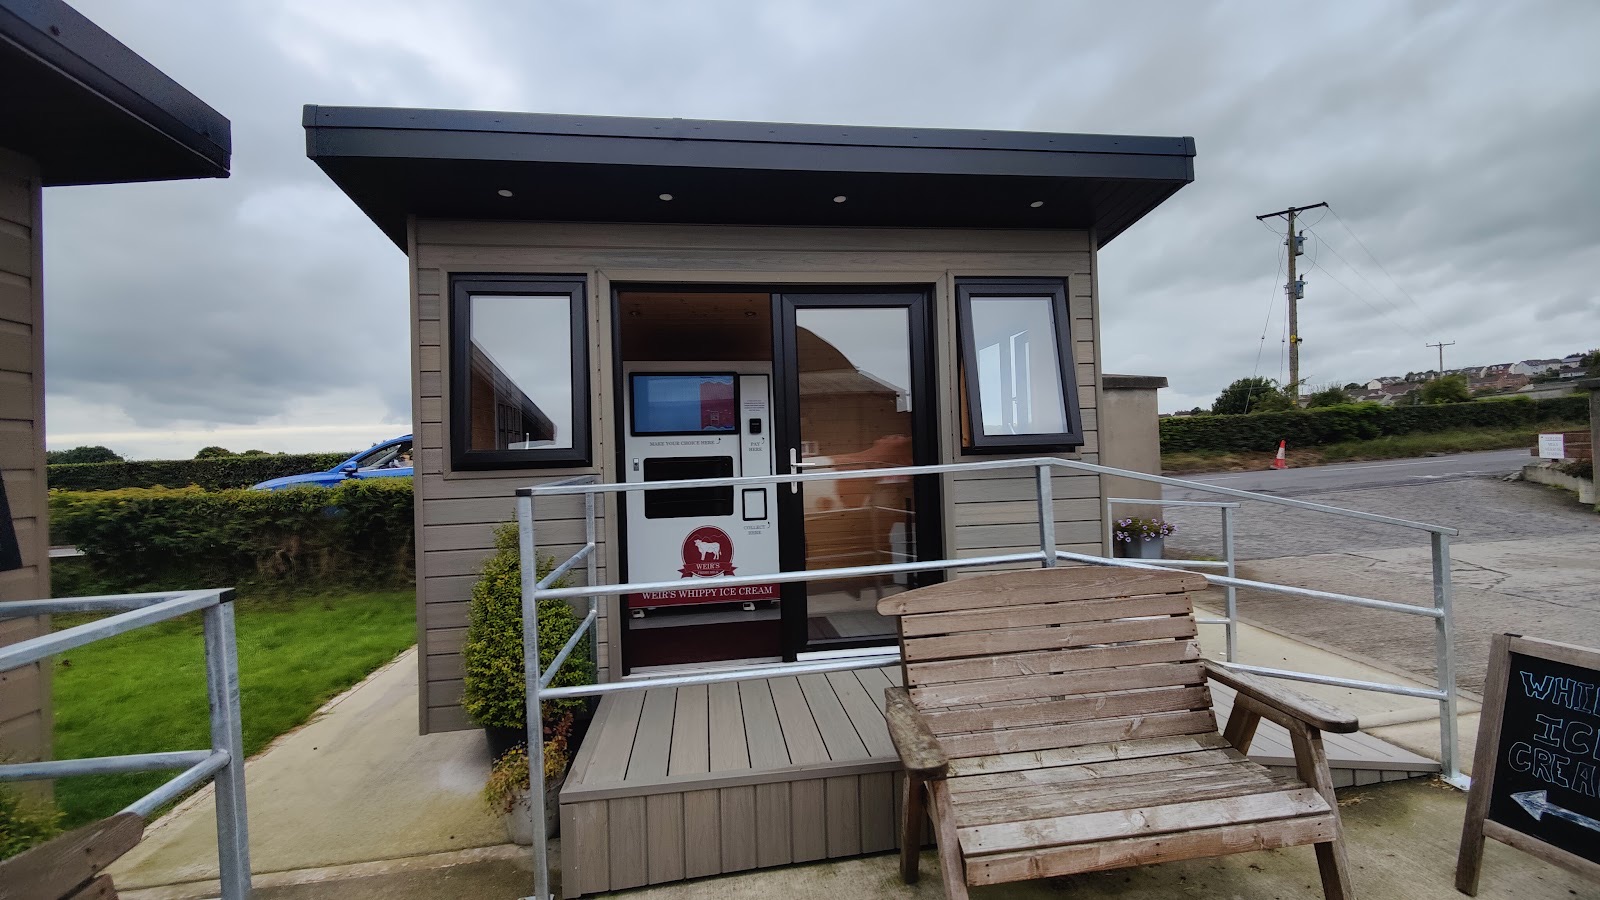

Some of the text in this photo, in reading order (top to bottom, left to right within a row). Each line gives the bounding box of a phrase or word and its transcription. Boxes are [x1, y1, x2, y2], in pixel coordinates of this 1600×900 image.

[695, 562, 721, 570] WEIR'S
[642, 585, 773, 600] WEIR'S WHIPPY ICE CREAM
[1533, 713, 1600, 761] IC
[1508, 741, 1600, 798] CREA
